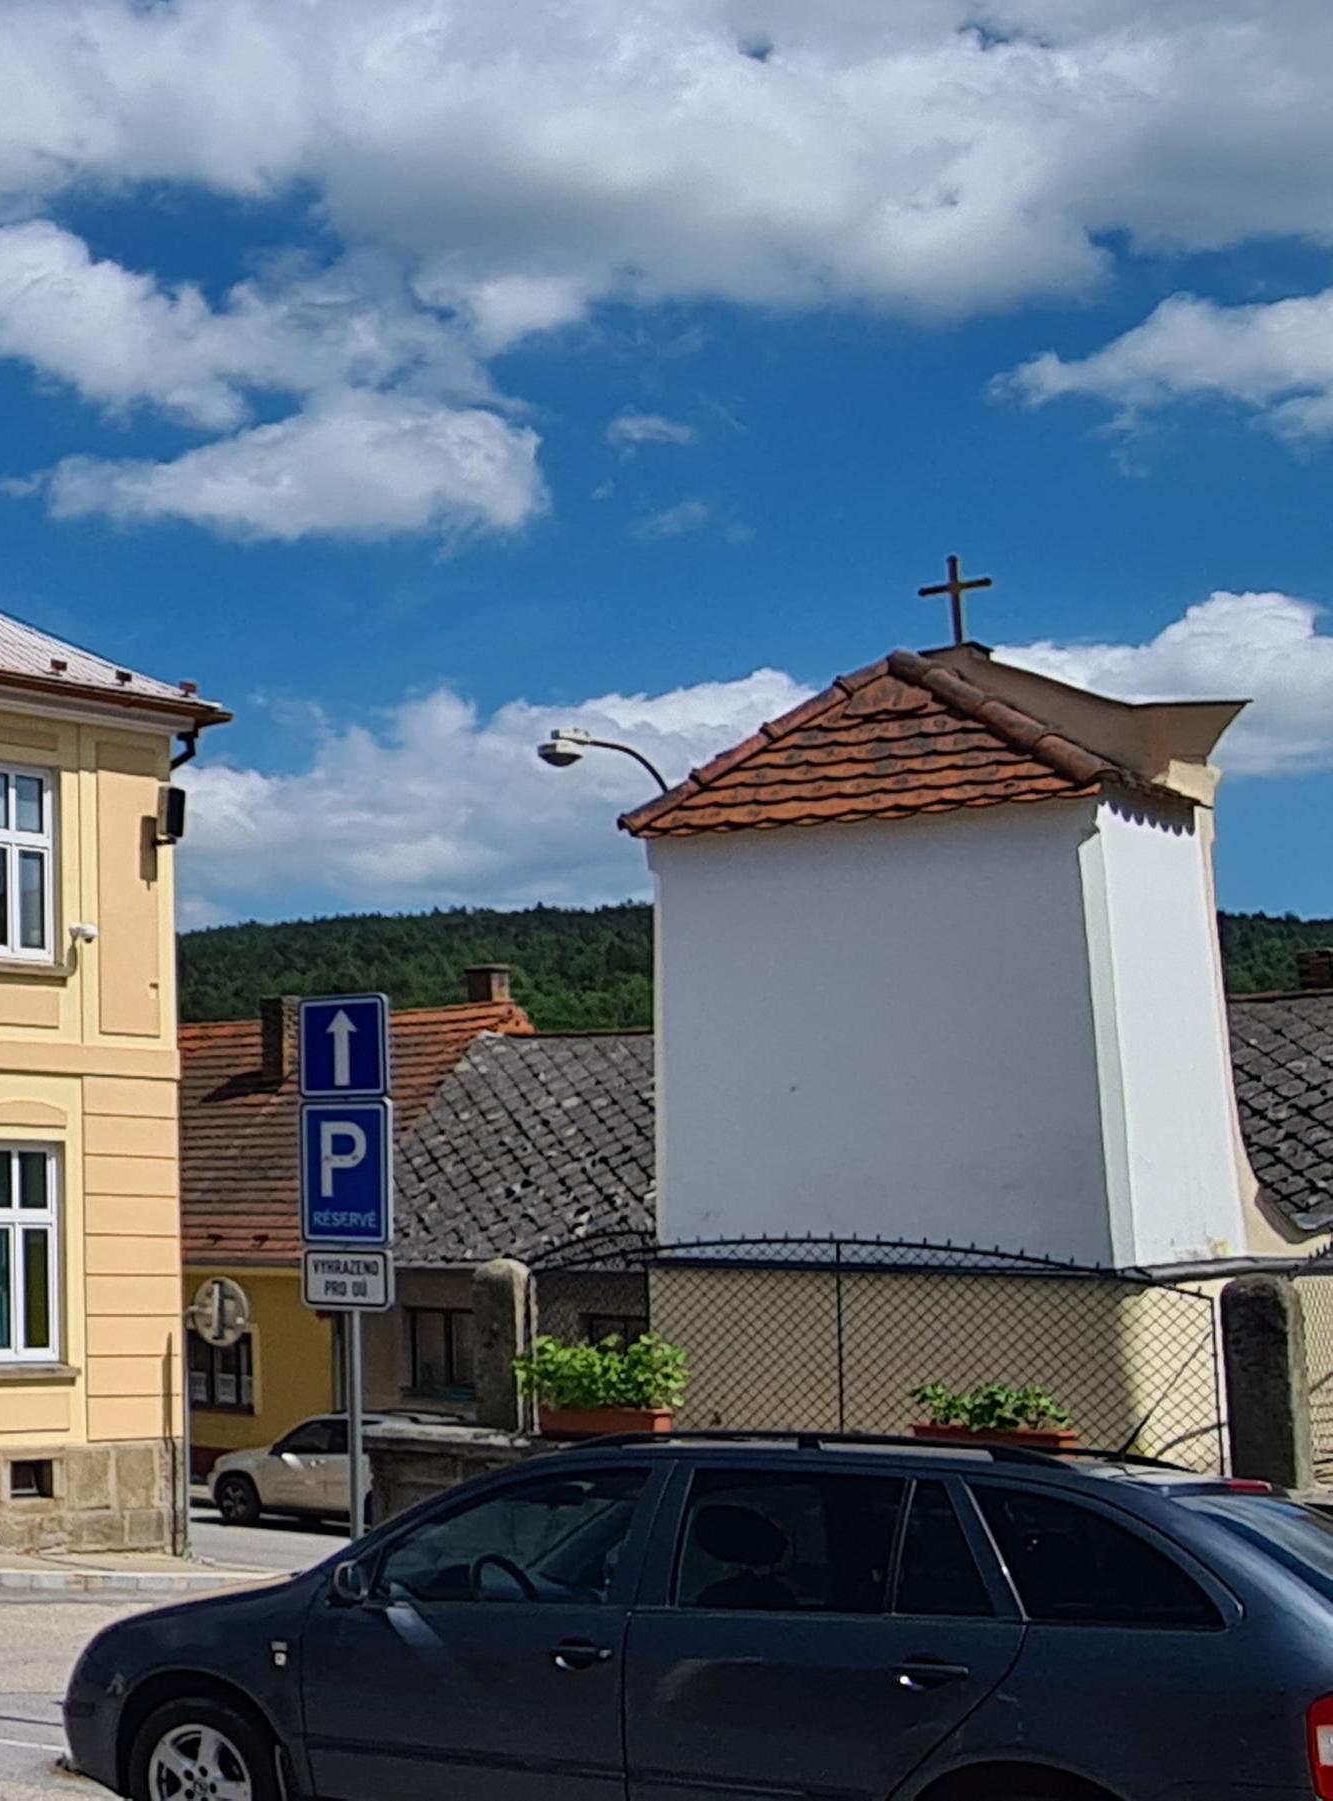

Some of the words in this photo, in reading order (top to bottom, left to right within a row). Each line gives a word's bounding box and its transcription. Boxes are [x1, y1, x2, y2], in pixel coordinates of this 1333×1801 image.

[320, 1121, 367, 1198] P
[313, 1209, 377, 1228] RÉSERVÉ
[312, 1259, 379, 1277] VYHRAZENO
[324, 1280, 347, 1297] PRO
